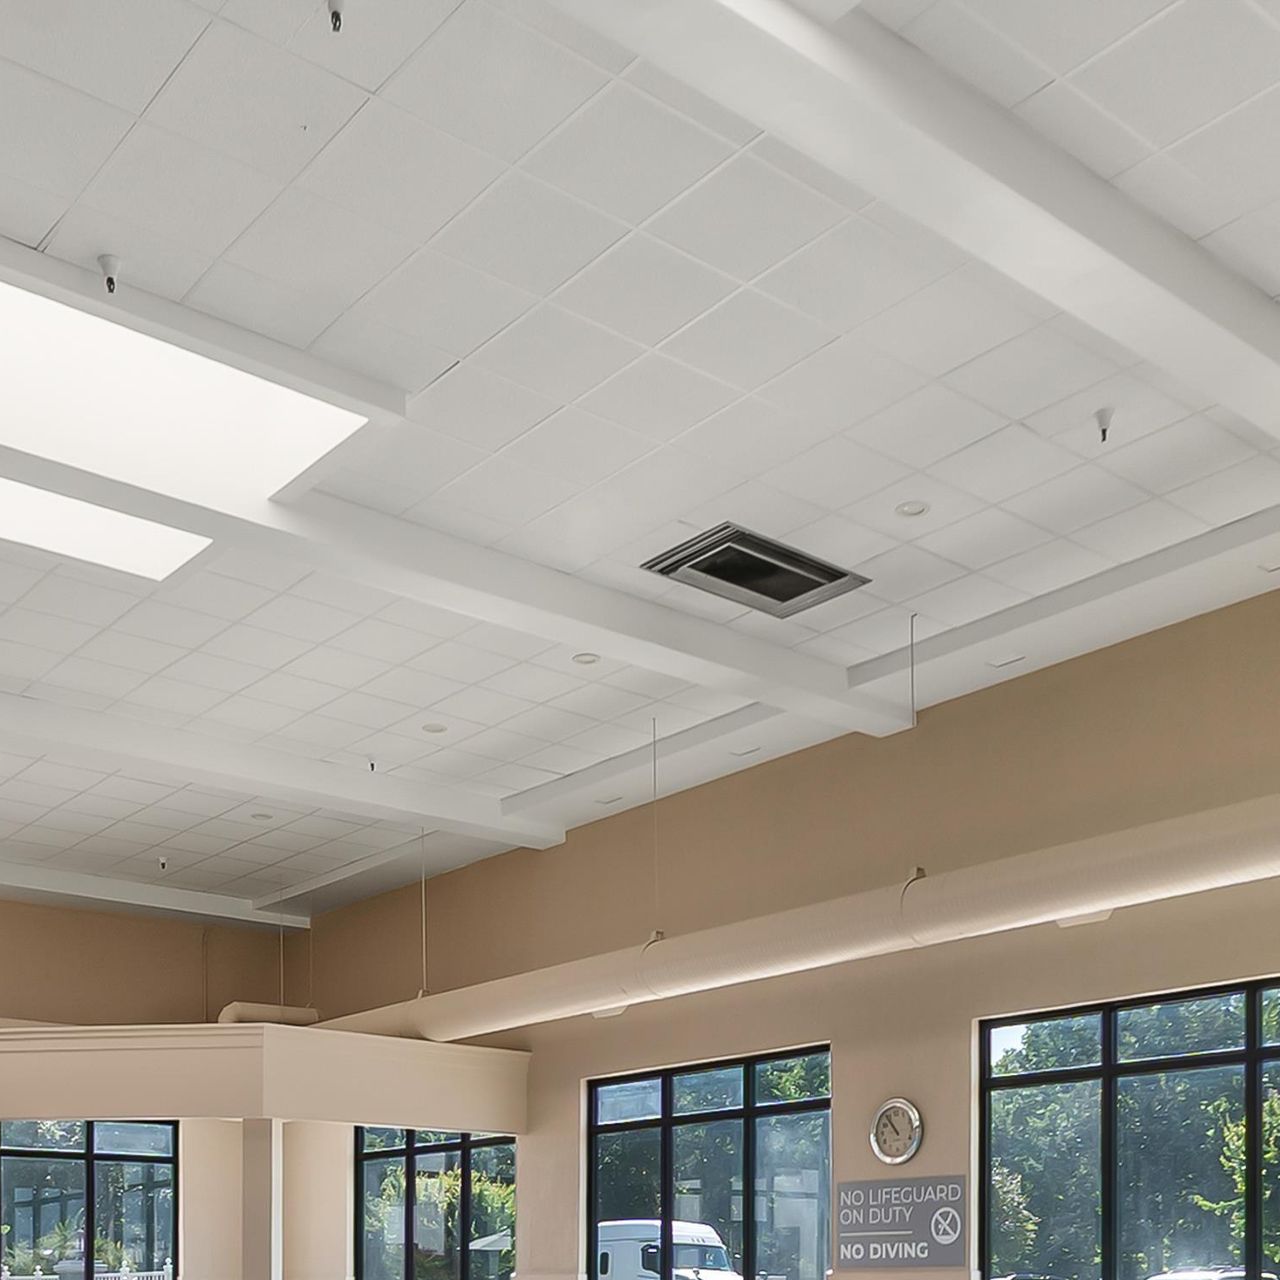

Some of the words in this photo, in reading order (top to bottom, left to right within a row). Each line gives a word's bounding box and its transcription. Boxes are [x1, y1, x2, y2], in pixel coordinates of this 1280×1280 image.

[840, 1190, 864, 1206] NO
[870, 1184, 961, 1205] LIFEGUARD
[840, 1208, 863, 1225] ON
[870, 1206, 913, 1224] DUTY
[840, 1244, 864, 1259] NO
[870, 1242, 928, 1259] DIVING
